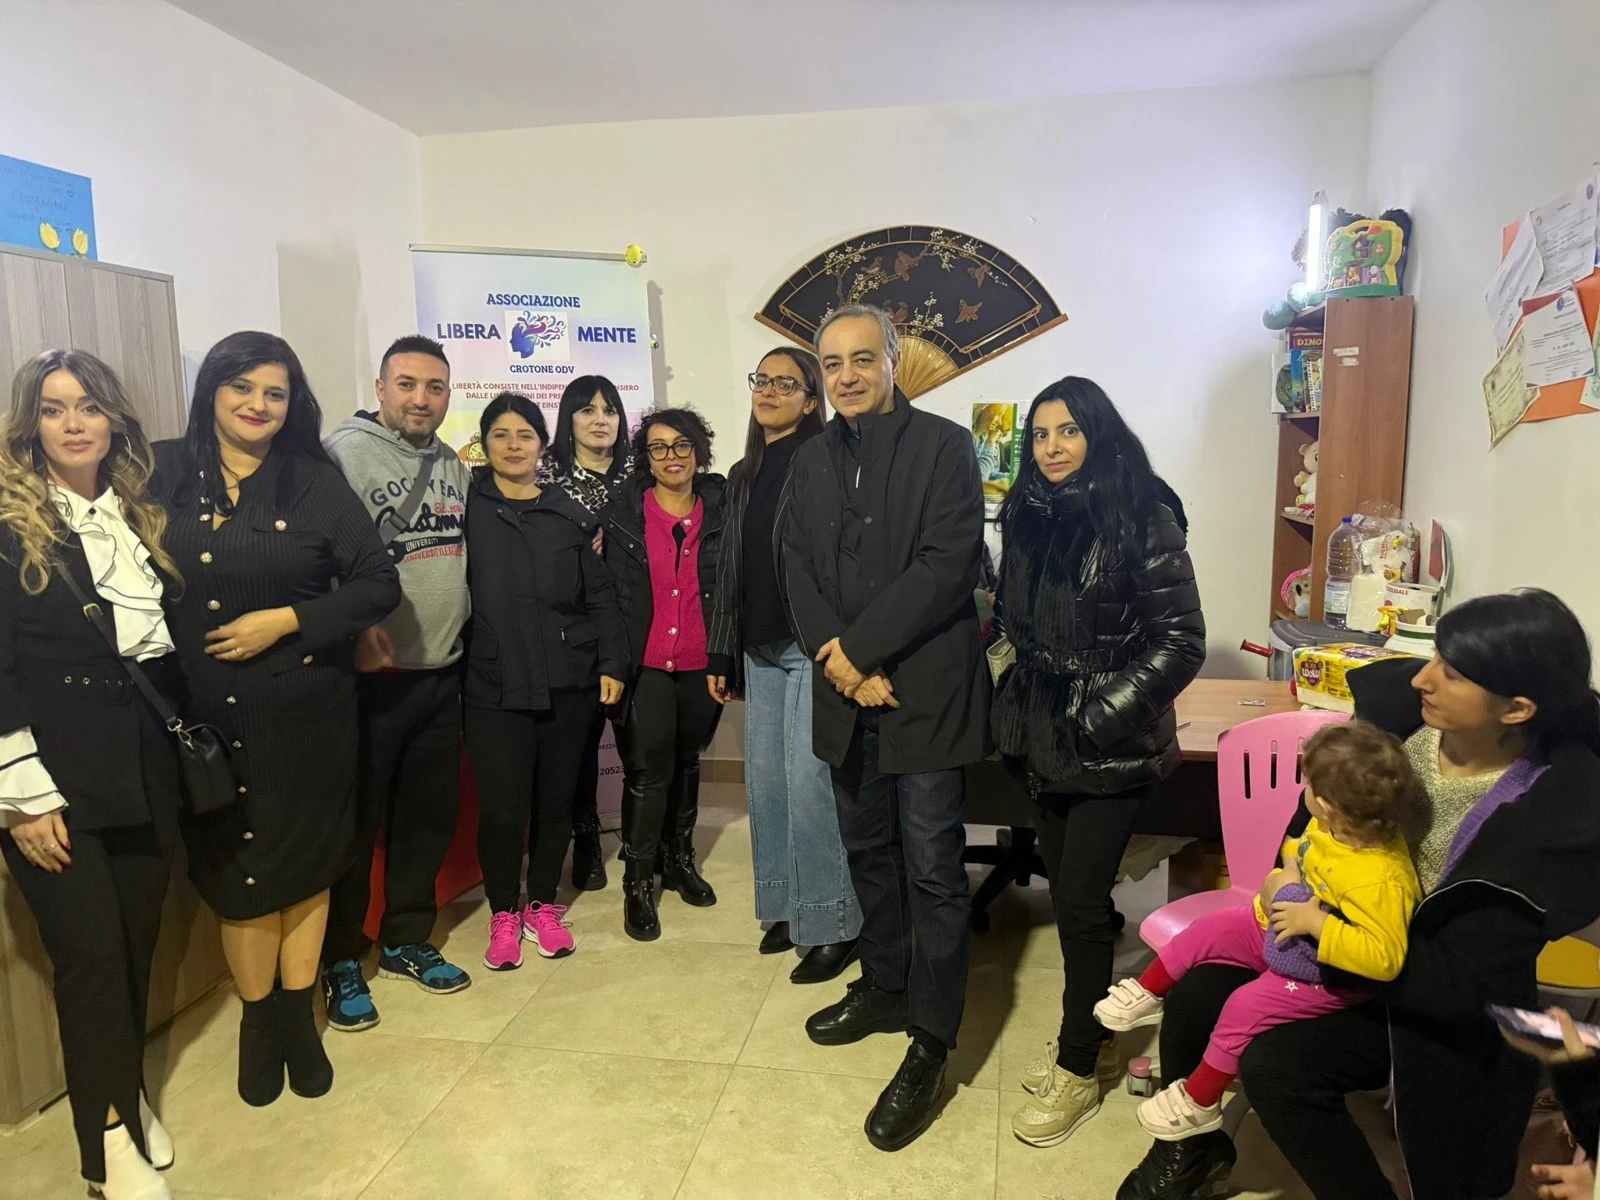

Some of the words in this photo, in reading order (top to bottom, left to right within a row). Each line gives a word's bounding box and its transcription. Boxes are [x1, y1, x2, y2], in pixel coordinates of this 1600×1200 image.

[486, 293, 581, 308] ASSOCIAZIONE
[437, 324, 501, 340] LIBERA
[578, 327, 636, 343] MENTE
[509, 364, 554, 374] CROTONE
[555, 365, 575, 374] ODV
[452, 381, 482, 390] LIBERTÀ
[483, 382, 520, 390] CONSISTE
